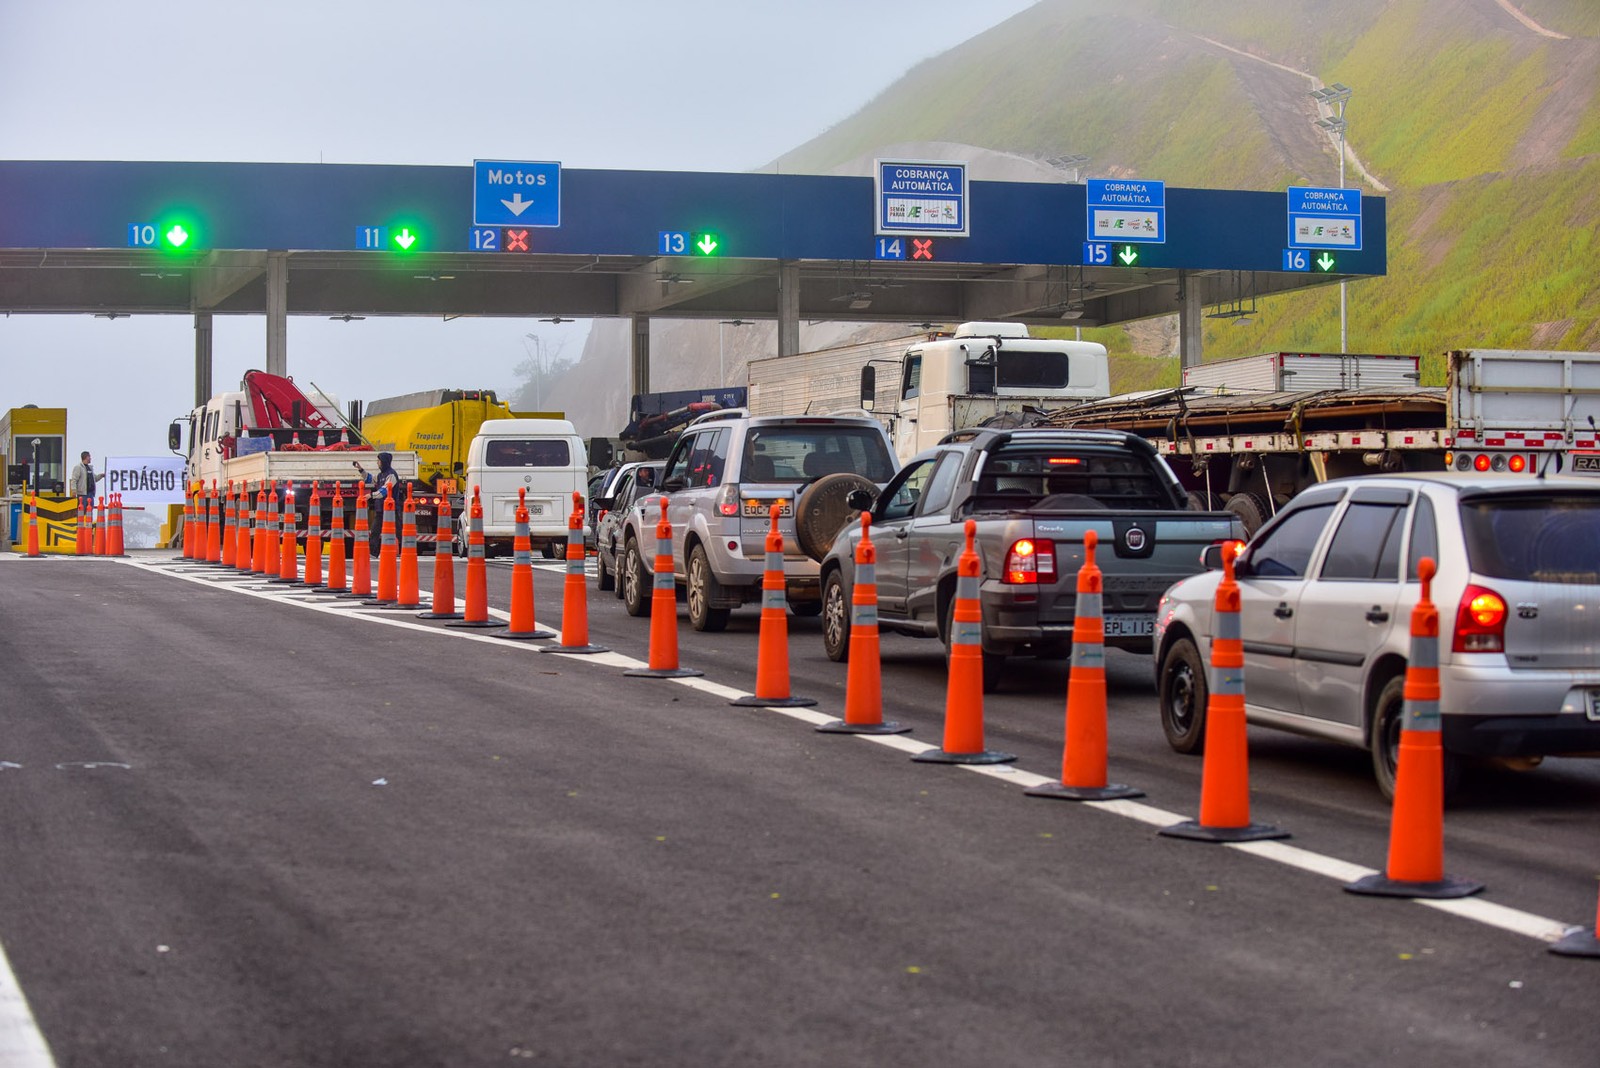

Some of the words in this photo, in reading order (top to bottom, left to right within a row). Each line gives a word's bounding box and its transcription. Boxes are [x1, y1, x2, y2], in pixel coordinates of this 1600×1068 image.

[488, 169, 547, 186] Motos
[895, 169, 950, 181] COBRANÇA
[891, 180, 954, 192] AUTOMÁTICA
[1105, 183, 1147, 194] COBRANÇA
[1101, 193, 1151, 204] AUTOMÁTICA
[1304, 191, 1345, 202] COBRANÇA
[1301, 201, 1349, 212] AUTOMÁTICA
[132, 225, 155, 245] 10
[364, 228, 379, 248] 11
[474, 229, 496, 249] 12
[663, 233, 685, 253] 13
[879, 238, 901, 258] 14
[1087, 244, 1108, 263] 15
[1287, 251, 1306, 269] 16
[416, 432, 445, 440] Tropical
[409, 442, 450, 450] Transportes
[110, 465, 175, 491] PEDÁGIO
